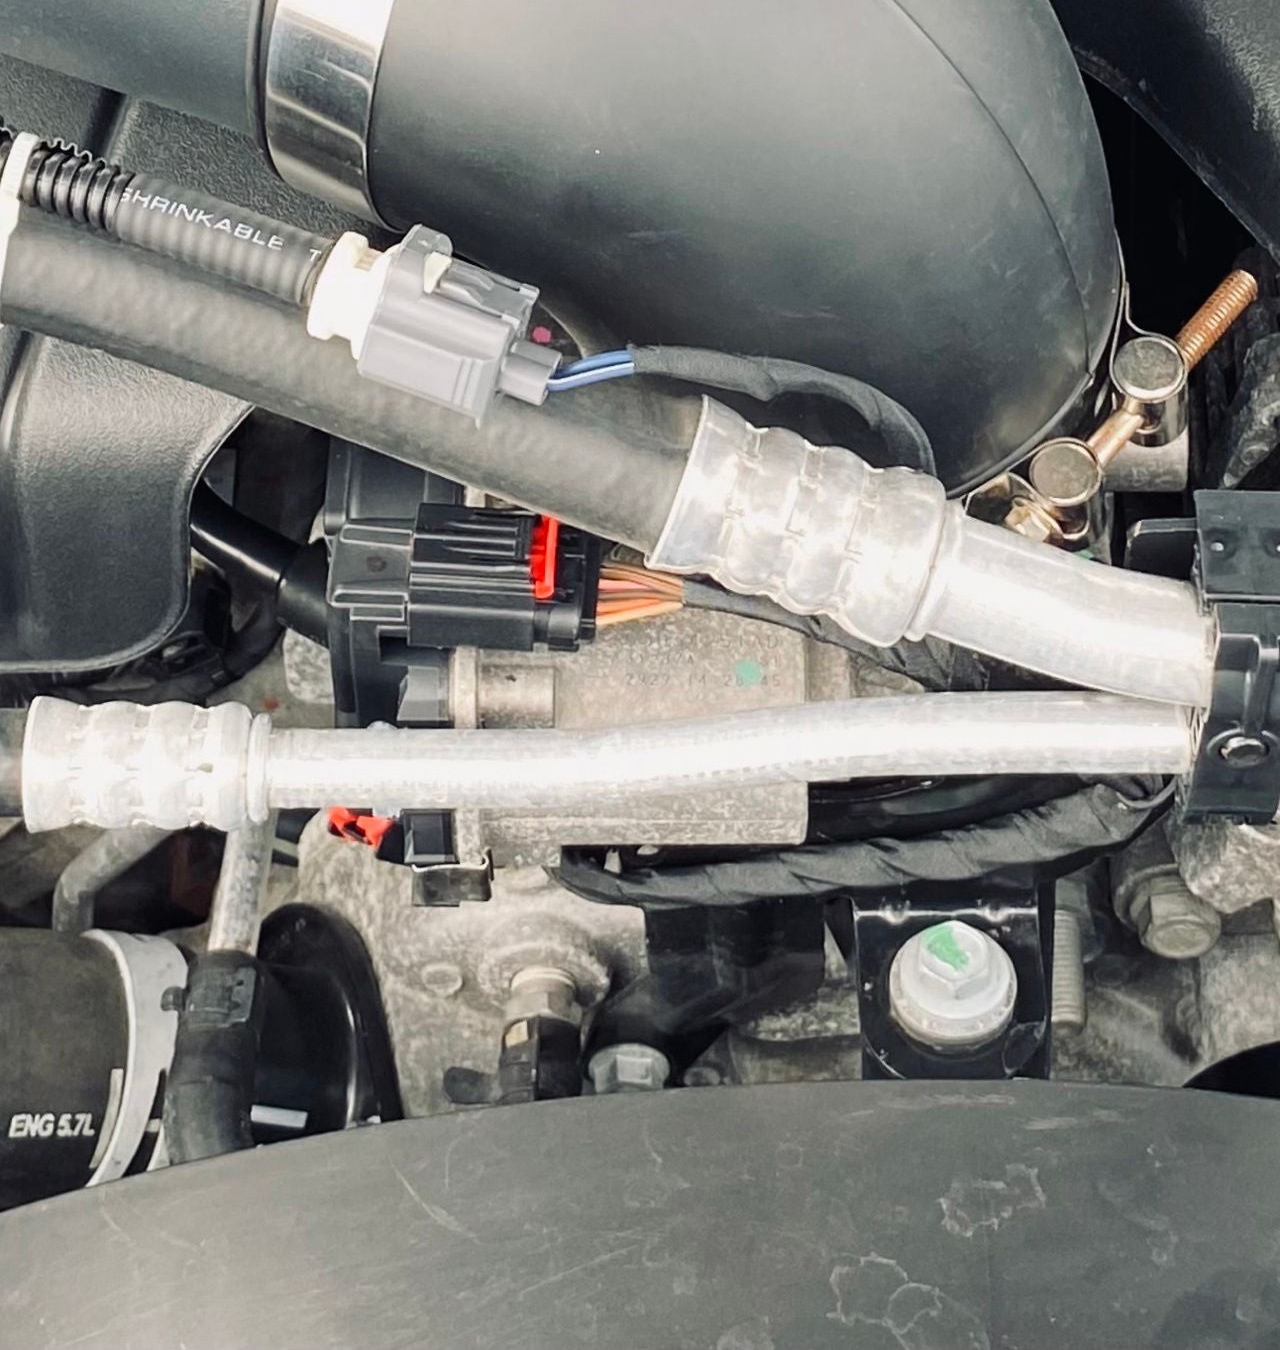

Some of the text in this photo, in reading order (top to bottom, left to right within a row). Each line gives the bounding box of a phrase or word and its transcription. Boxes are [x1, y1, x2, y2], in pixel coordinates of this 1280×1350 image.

[120, 186, 286, 251] SHRINKABLE
[8, 1112, 96, 1138] ENG 5.7L
